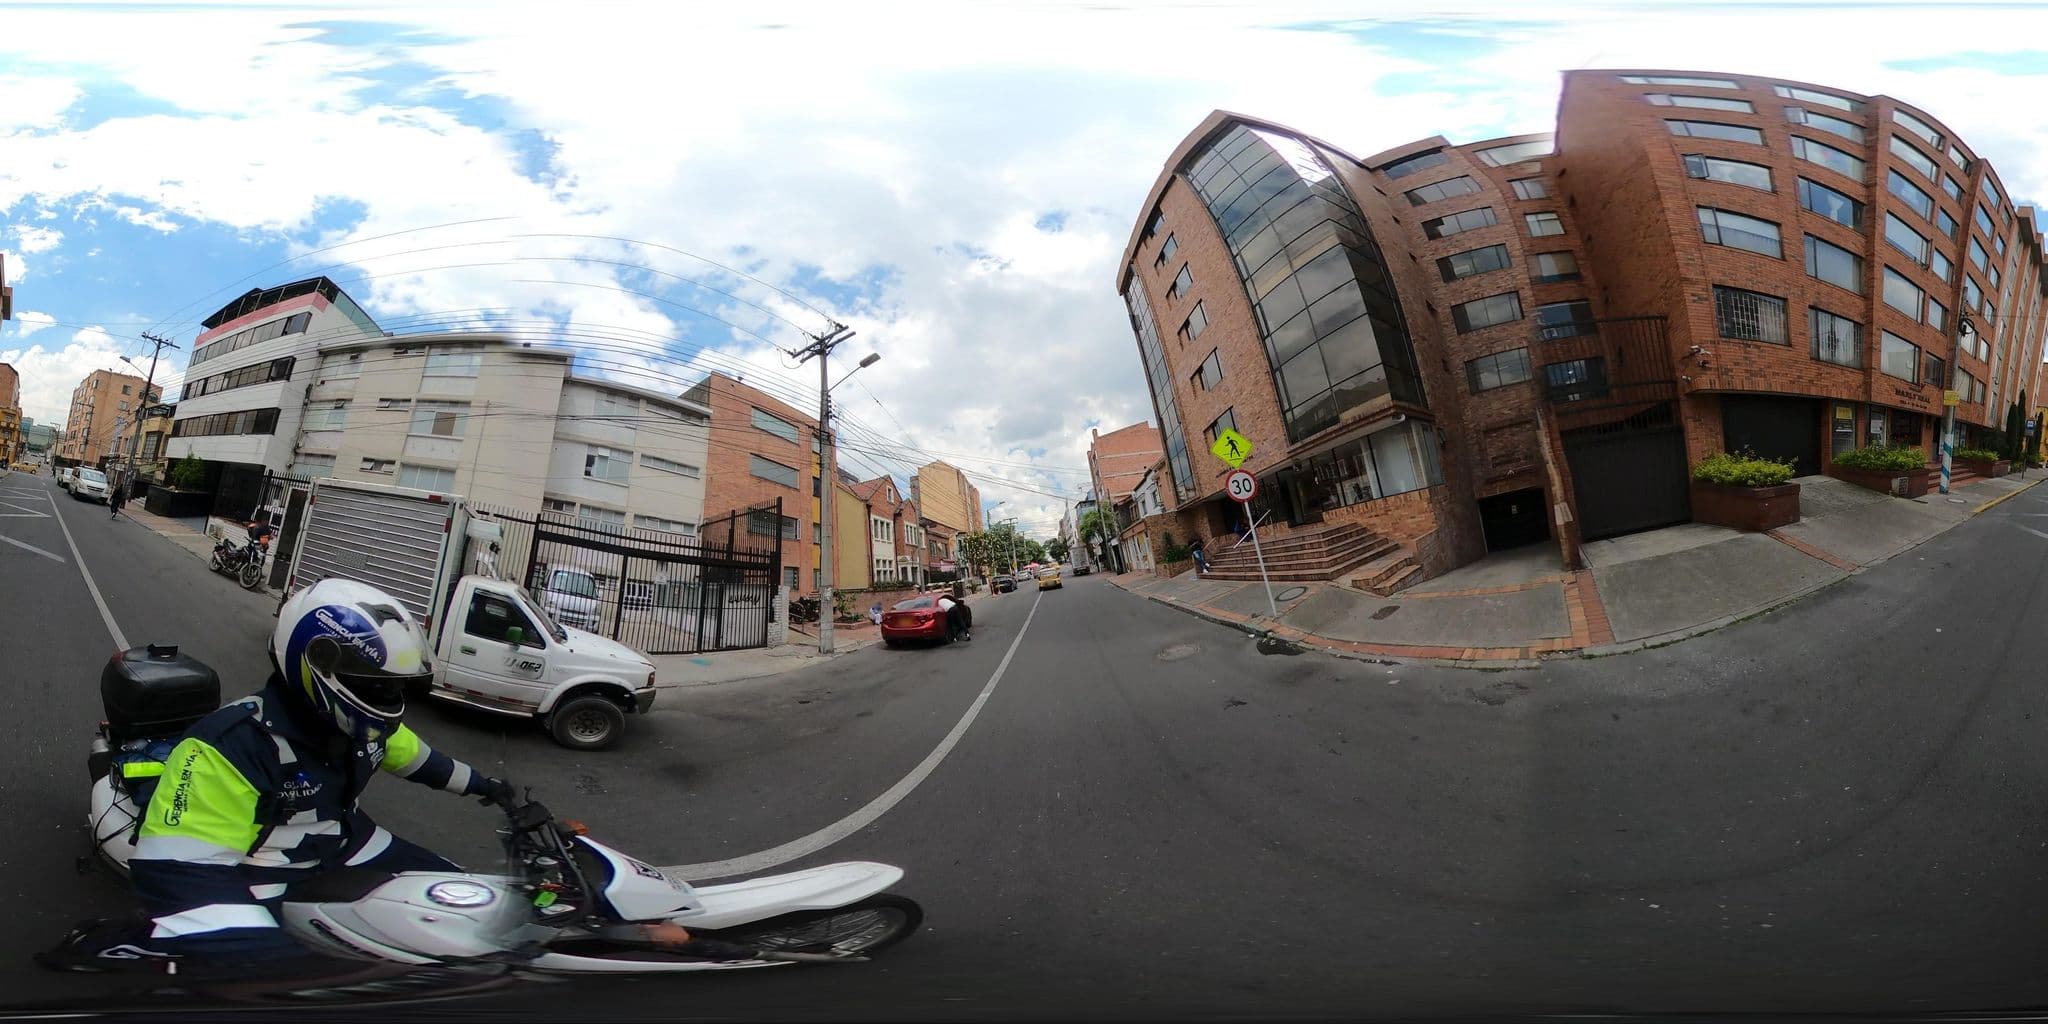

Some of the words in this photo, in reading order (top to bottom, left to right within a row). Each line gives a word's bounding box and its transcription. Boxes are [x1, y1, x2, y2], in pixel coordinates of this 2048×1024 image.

[1231, 478, 1252, 495] 30
[315, 608, 353, 640] GERENCIA
[164, 783, 186, 826] GERENCIA
[181, 768, 190, 782] EN
